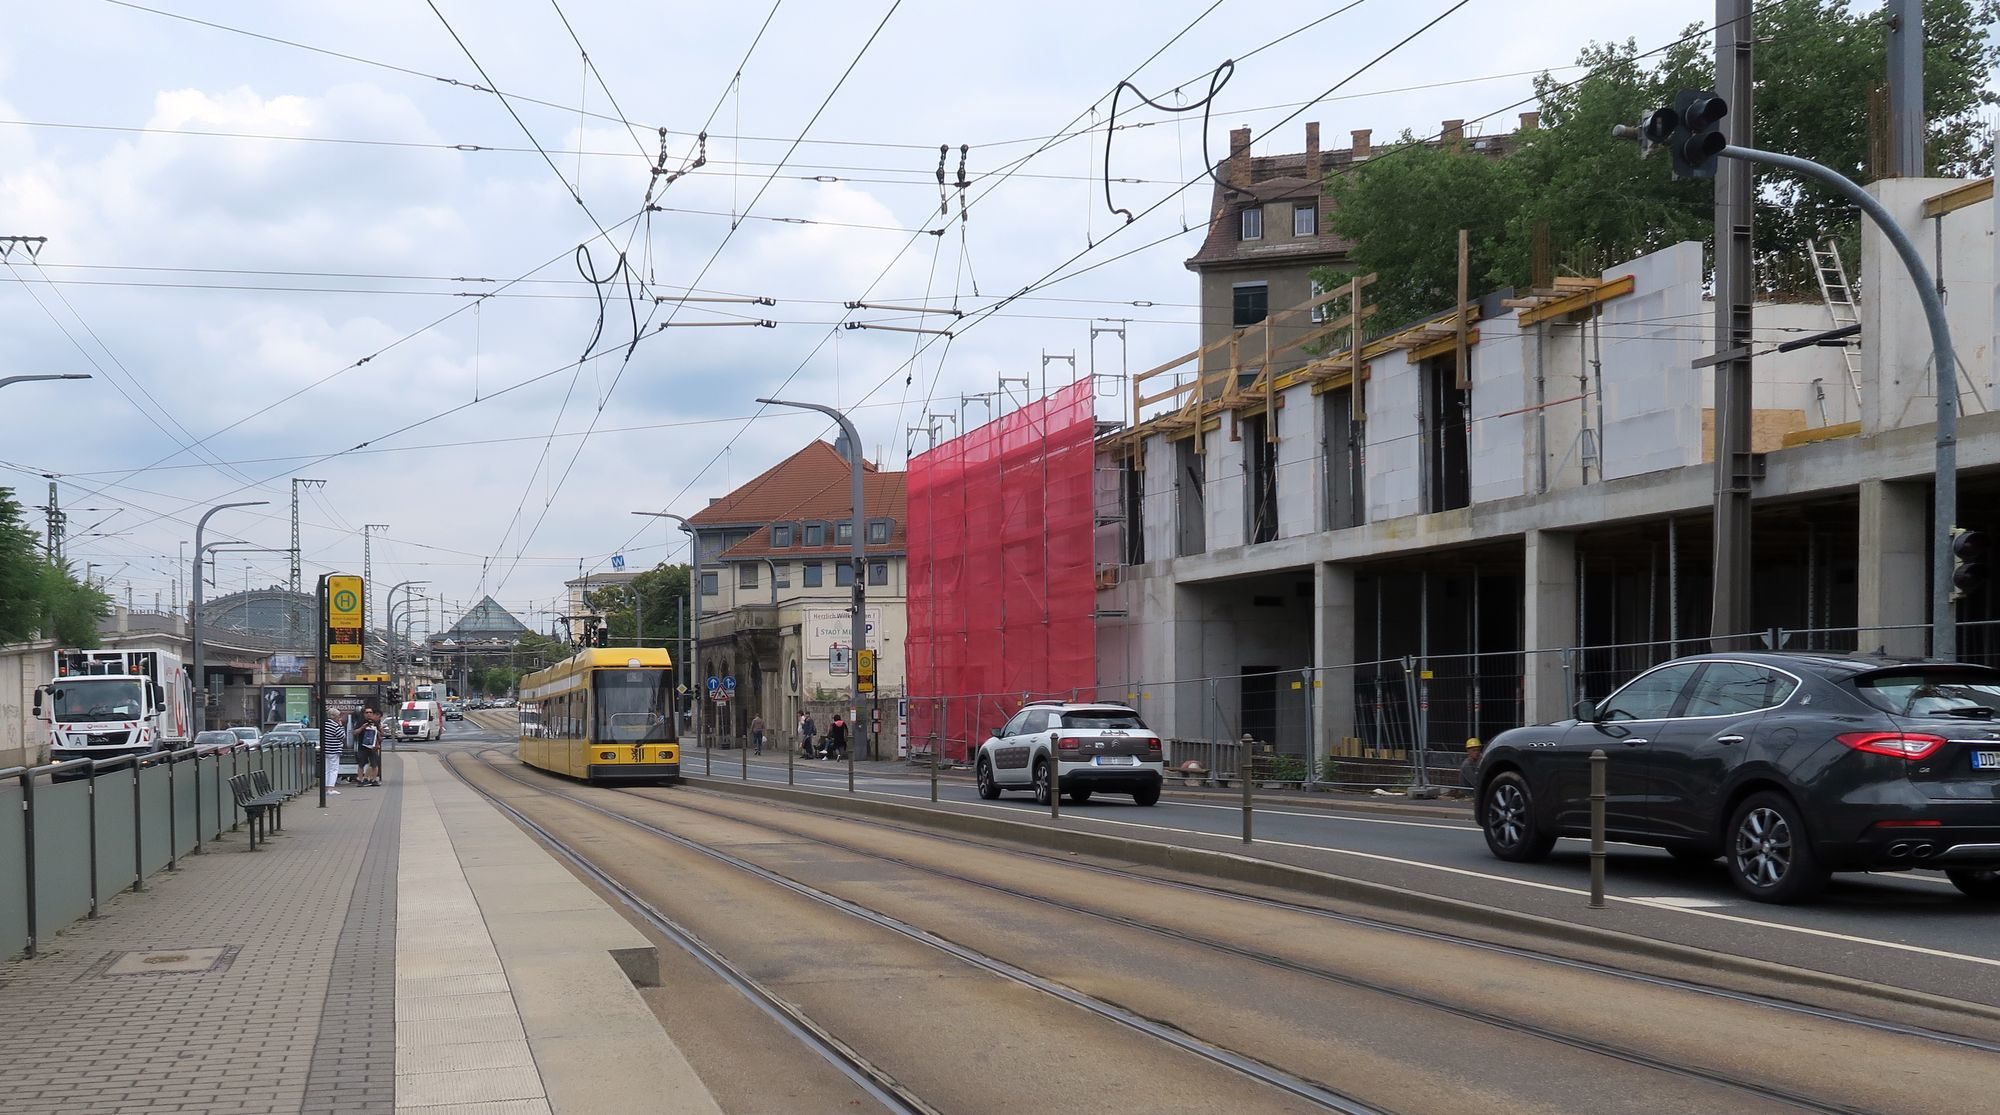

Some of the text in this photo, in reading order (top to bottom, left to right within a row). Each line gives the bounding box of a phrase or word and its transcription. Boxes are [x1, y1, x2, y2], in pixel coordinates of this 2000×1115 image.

[340, 595, 350, 608] H
[813, 612, 836, 620] Herzlich
[820, 628, 841, 636] STADT
[865, 624, 873, 634] P
[75, 737, 82, 746] A
